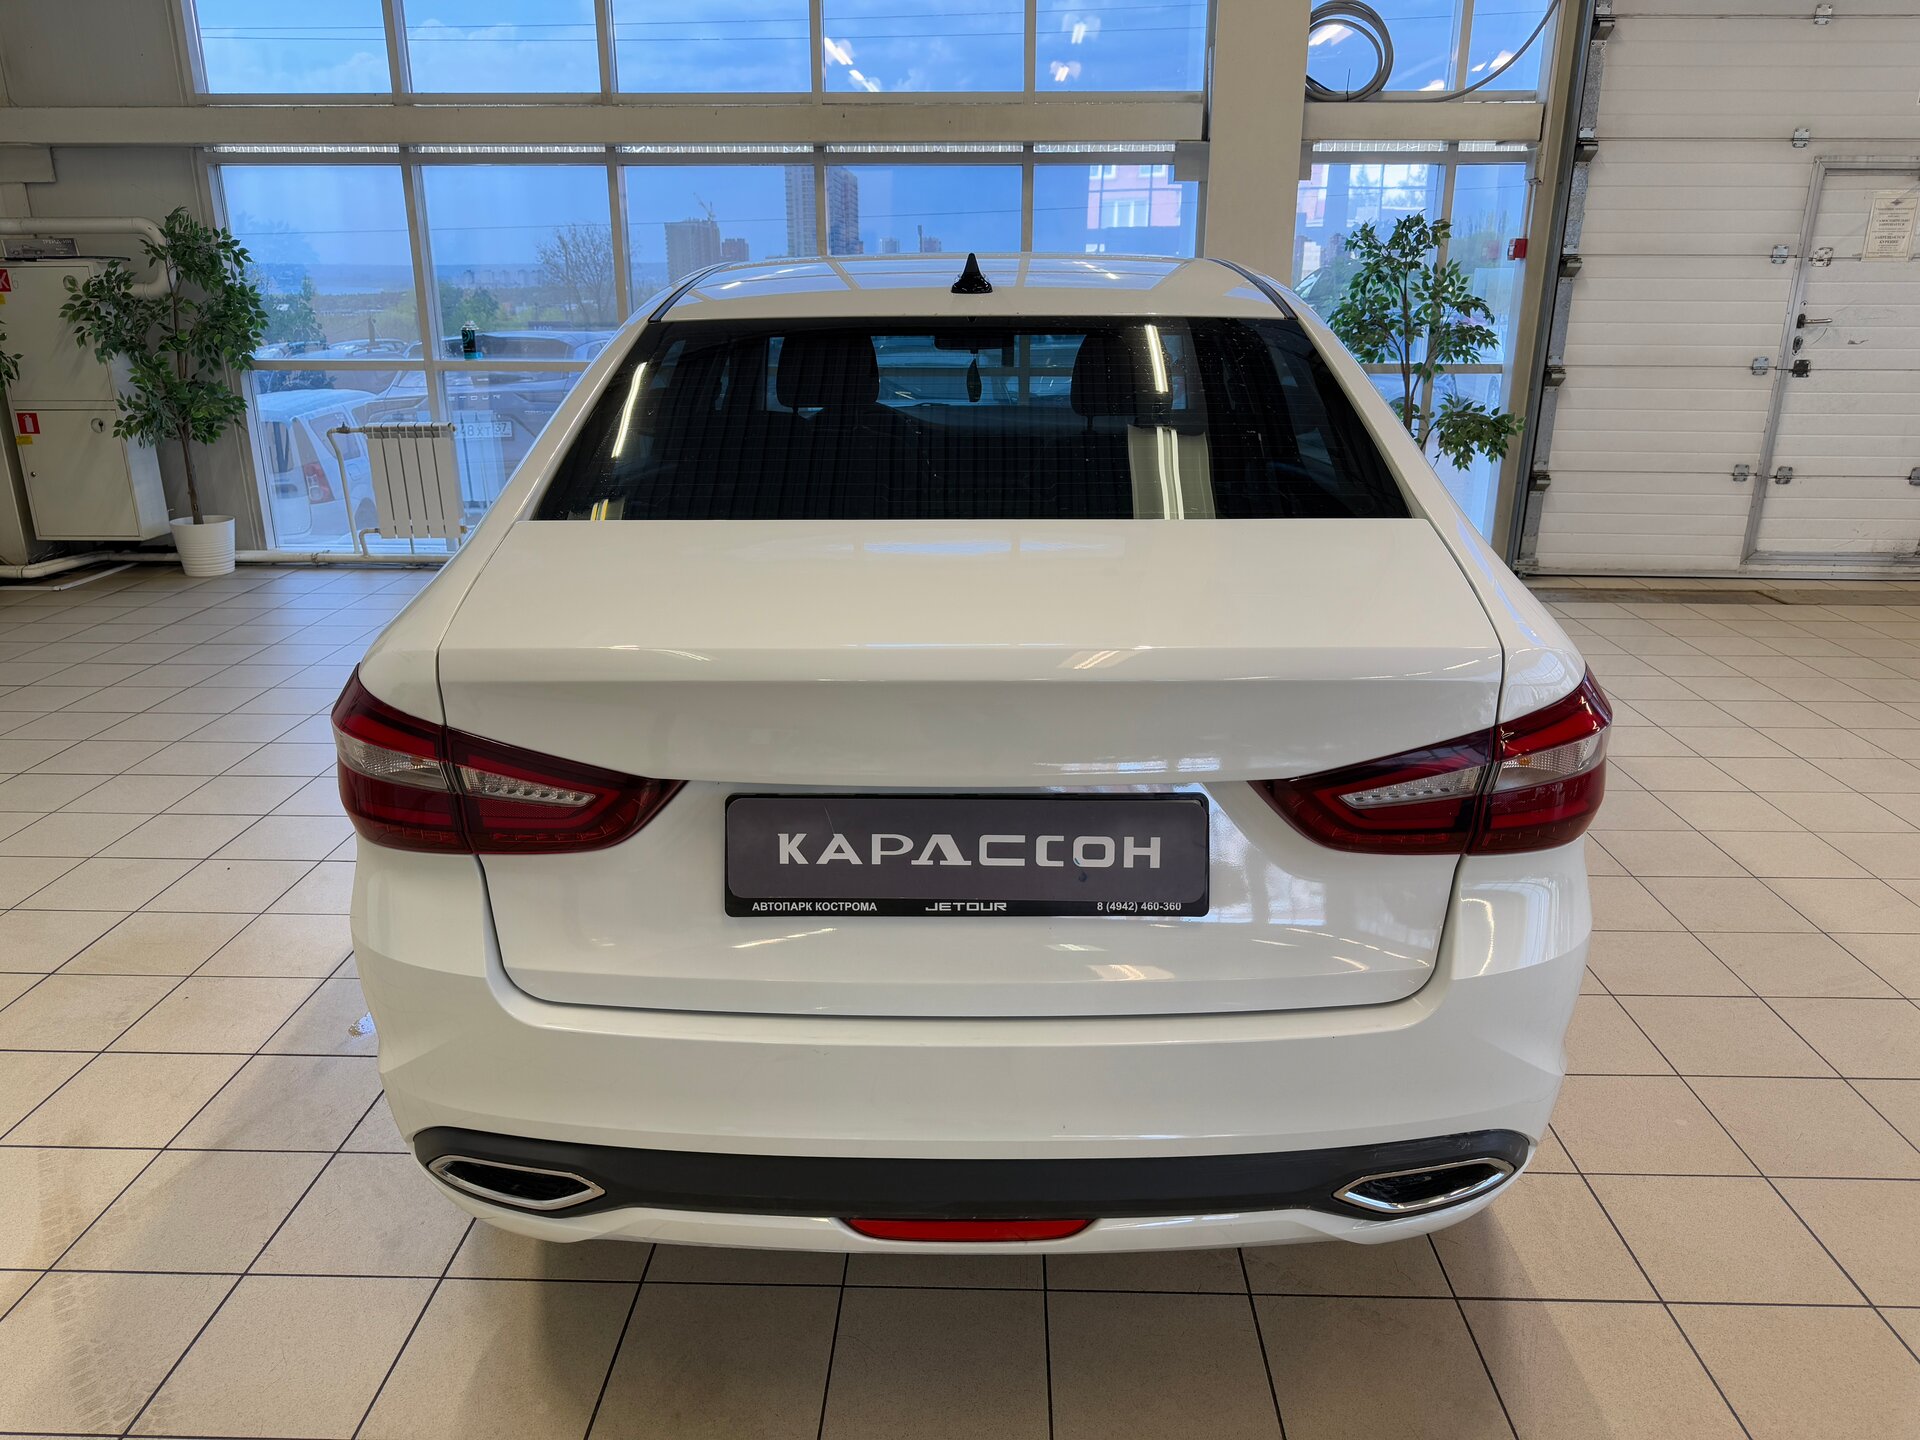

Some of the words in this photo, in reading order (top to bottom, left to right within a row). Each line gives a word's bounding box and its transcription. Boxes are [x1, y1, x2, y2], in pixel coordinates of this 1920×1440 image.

[778, 834, 1160, 868] КАРЛССОН
[752, 902, 812, 911] АВТОПАРК
[816, 902, 877, 911] КОСТРОМА
[926, 902, 1006, 911] JETOUR
[1097, 902, 1103, 911] 8
[1107, 902, 1137, 912] (4942)
[1141, 902, 1181, 911] 460-360
